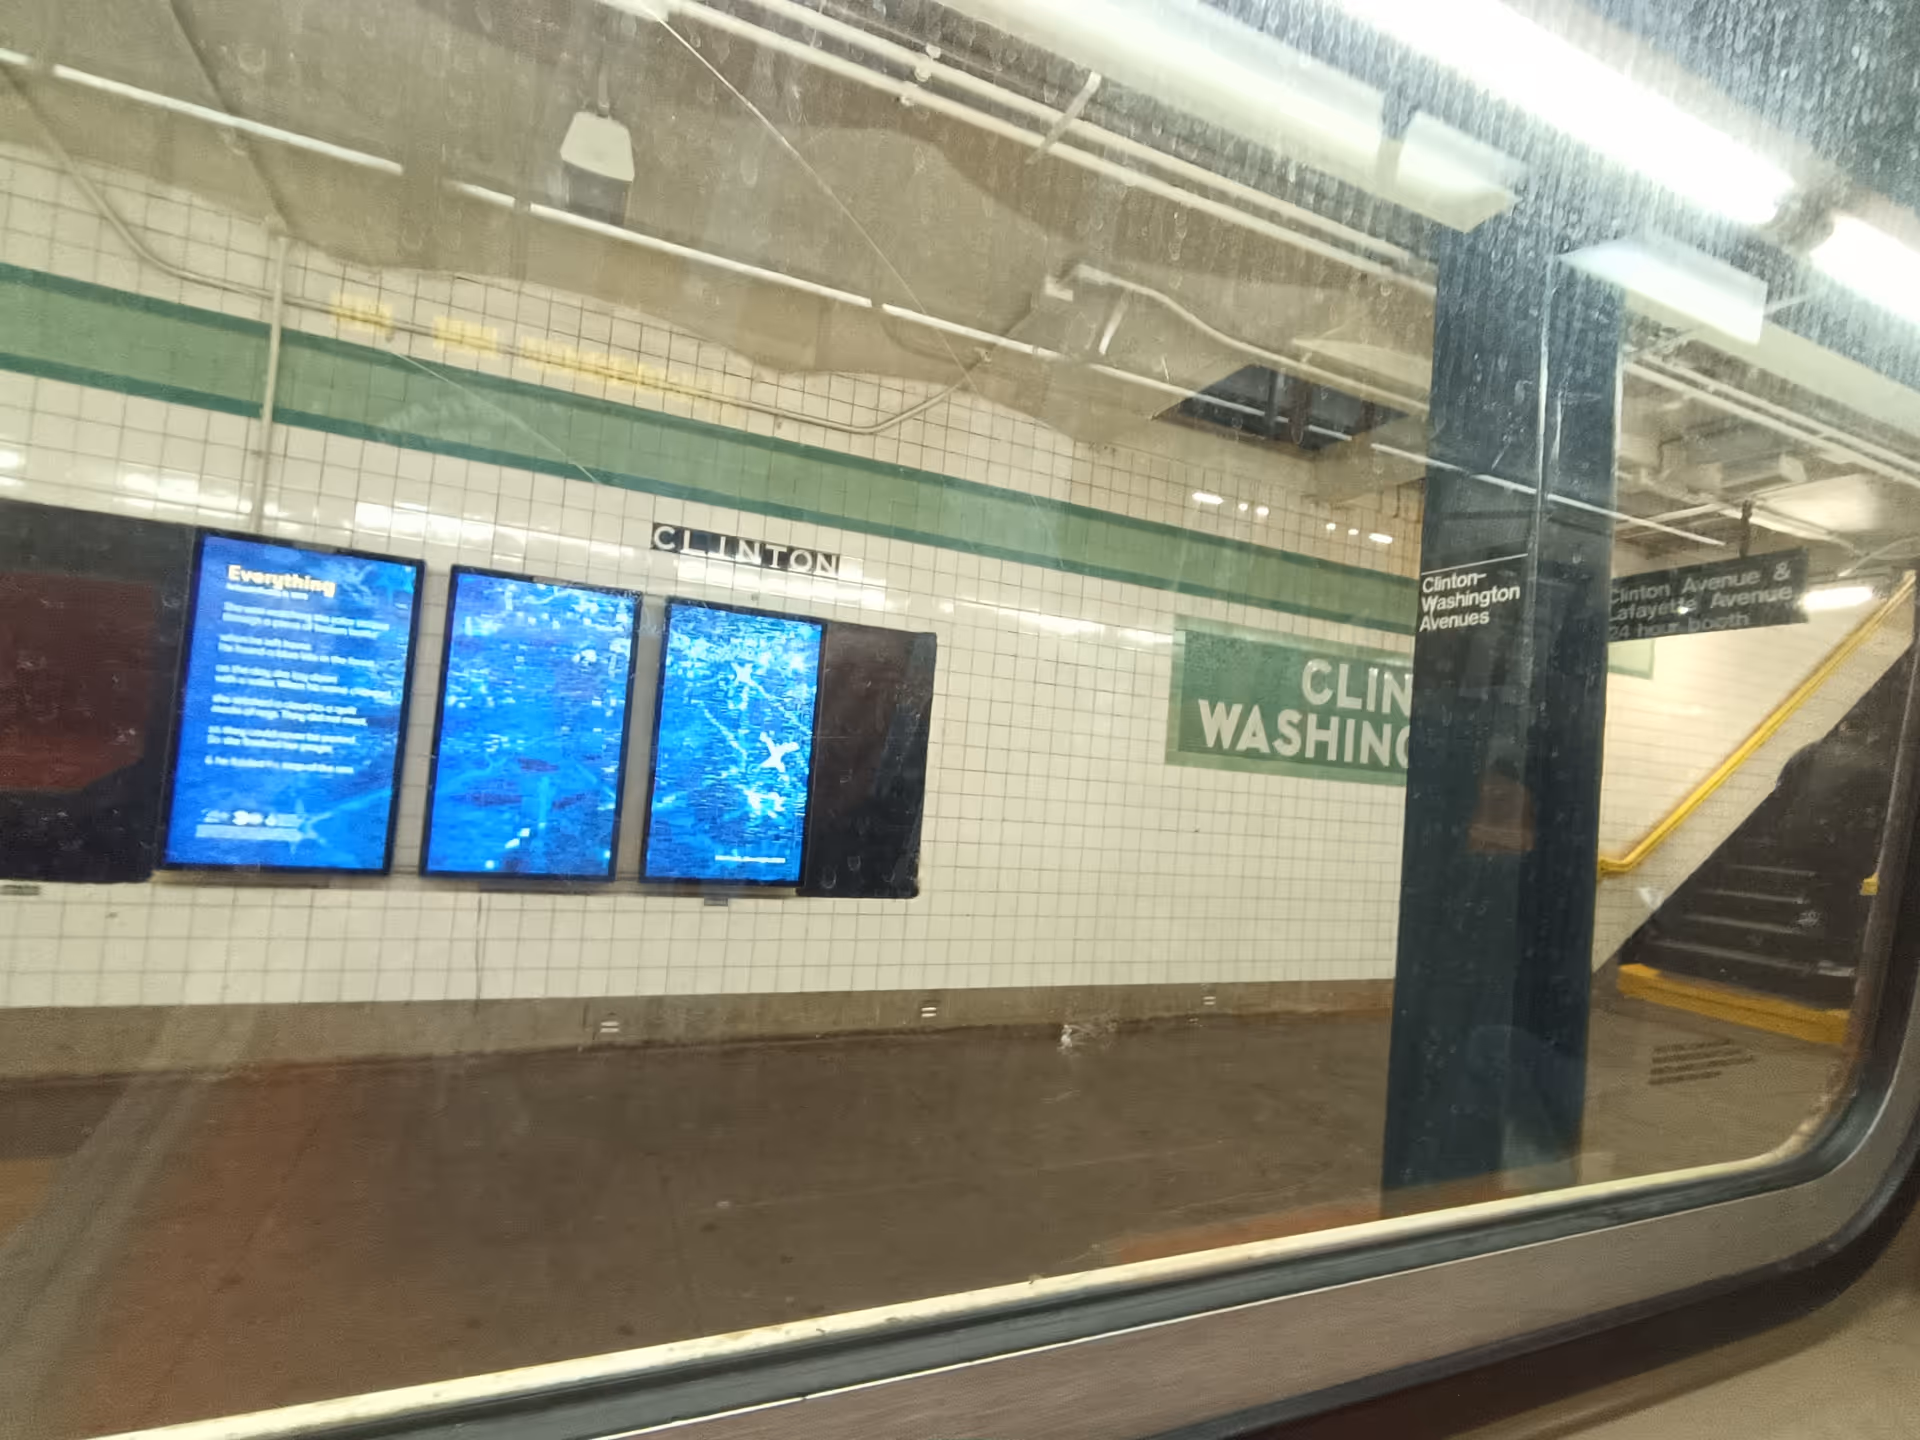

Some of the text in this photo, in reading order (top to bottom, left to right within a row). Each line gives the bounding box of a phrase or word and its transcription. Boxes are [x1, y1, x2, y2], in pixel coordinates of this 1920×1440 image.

[653, 525, 838, 579] CLINTON
[227, 564, 336, 598] Everything
[1422, 572, 1487, 593] Clinton-
[1680, 569, 1761, 594] Avenue
[1421, 585, 1521, 613] Washington
[1709, 585, 1793, 609] Avenue
[1419, 611, 1490, 632] Avenues
